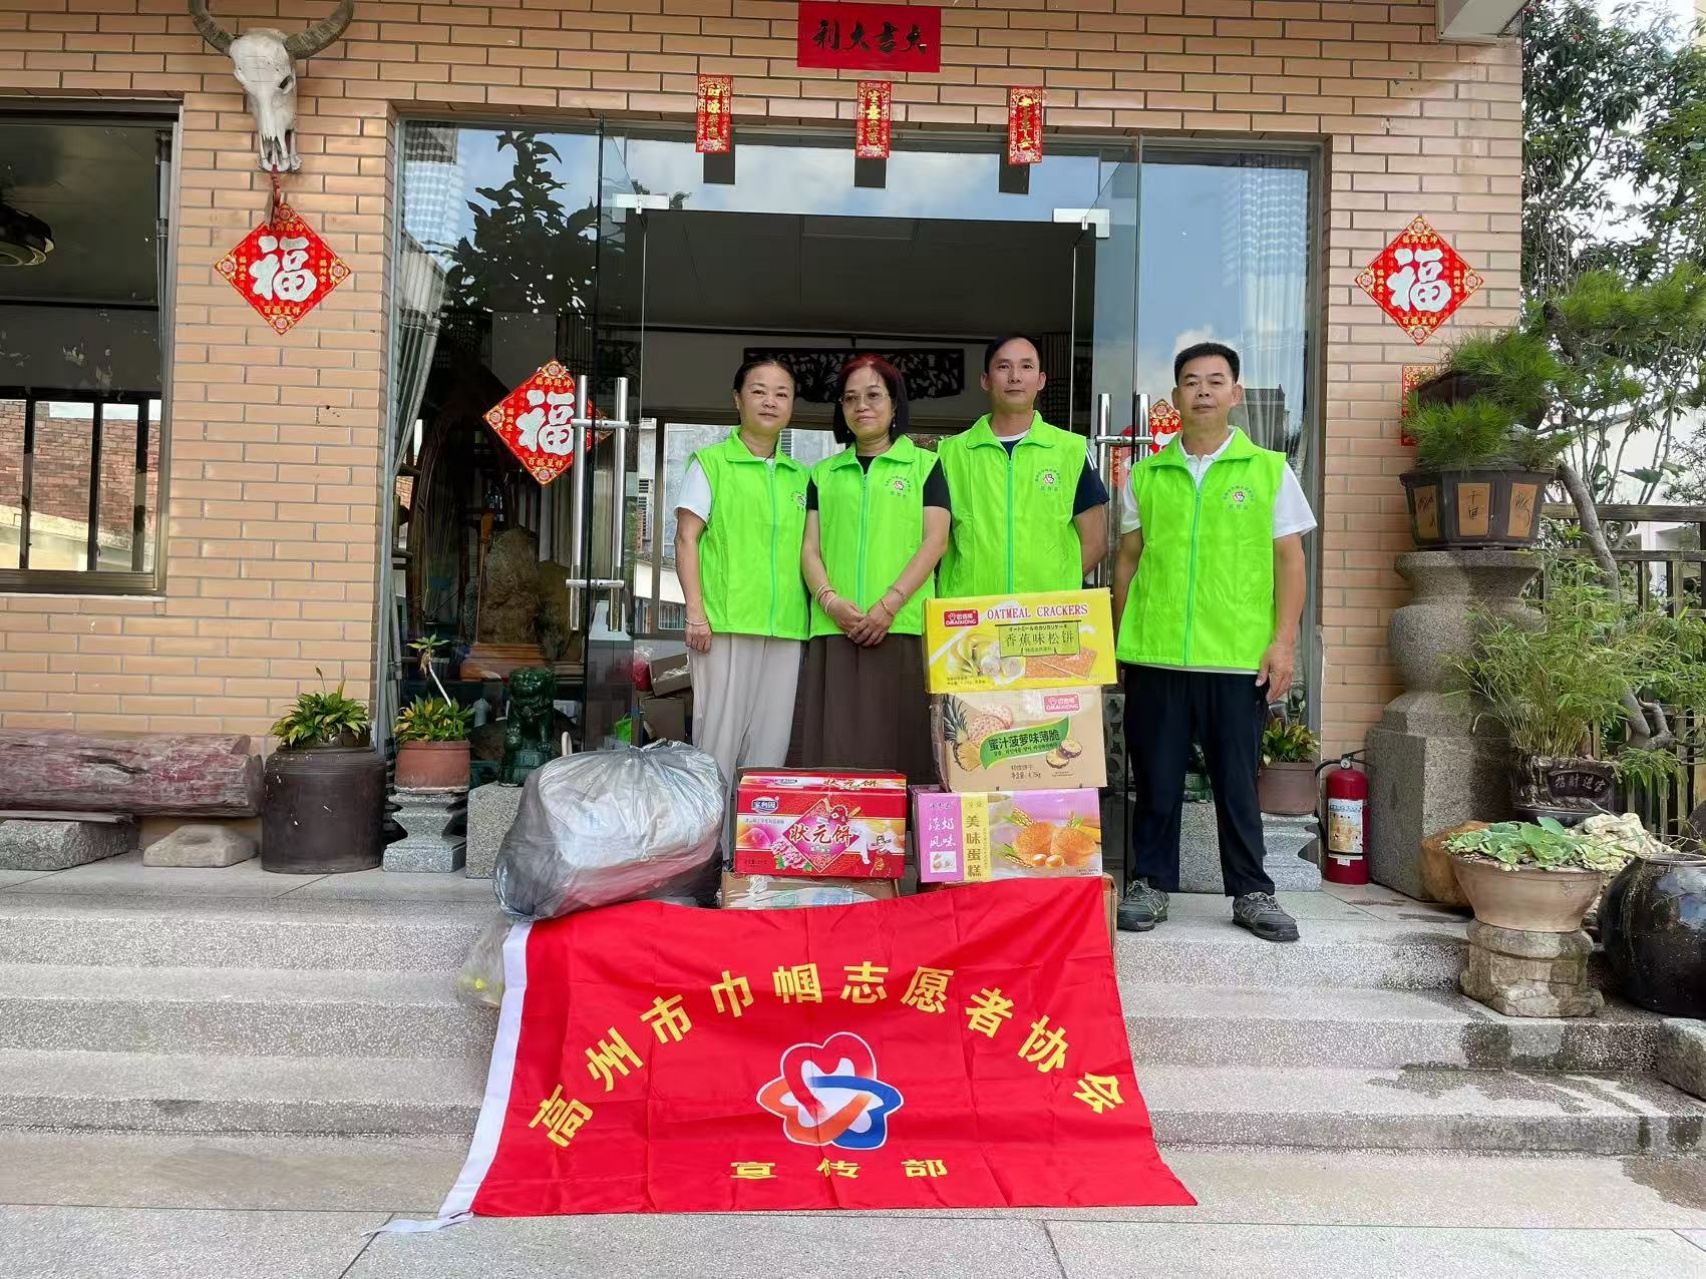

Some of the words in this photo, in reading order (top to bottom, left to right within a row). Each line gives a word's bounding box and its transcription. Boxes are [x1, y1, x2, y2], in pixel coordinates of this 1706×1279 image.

[248, 235, 318, 302] 福
[1386, 248, 1452, 313] 福
[516, 389, 575, 456] 福
[987, 607, 1031, 620] OATMEAL
[1037, 604, 1088, 618] CRACKERS
[1006, 630, 1075, 648] 香蕉味松饼
[988, 729, 1060, 751] 蜜汁菠萝味薄脆
[789, 824, 851, 845] 状元饼
[965, 815, 982, 878] 美味蛋糕
[529, 960, 1125, 1147] 高州市巾帼志愿者协会
[731, 1158, 948, 1179] 宣传部
